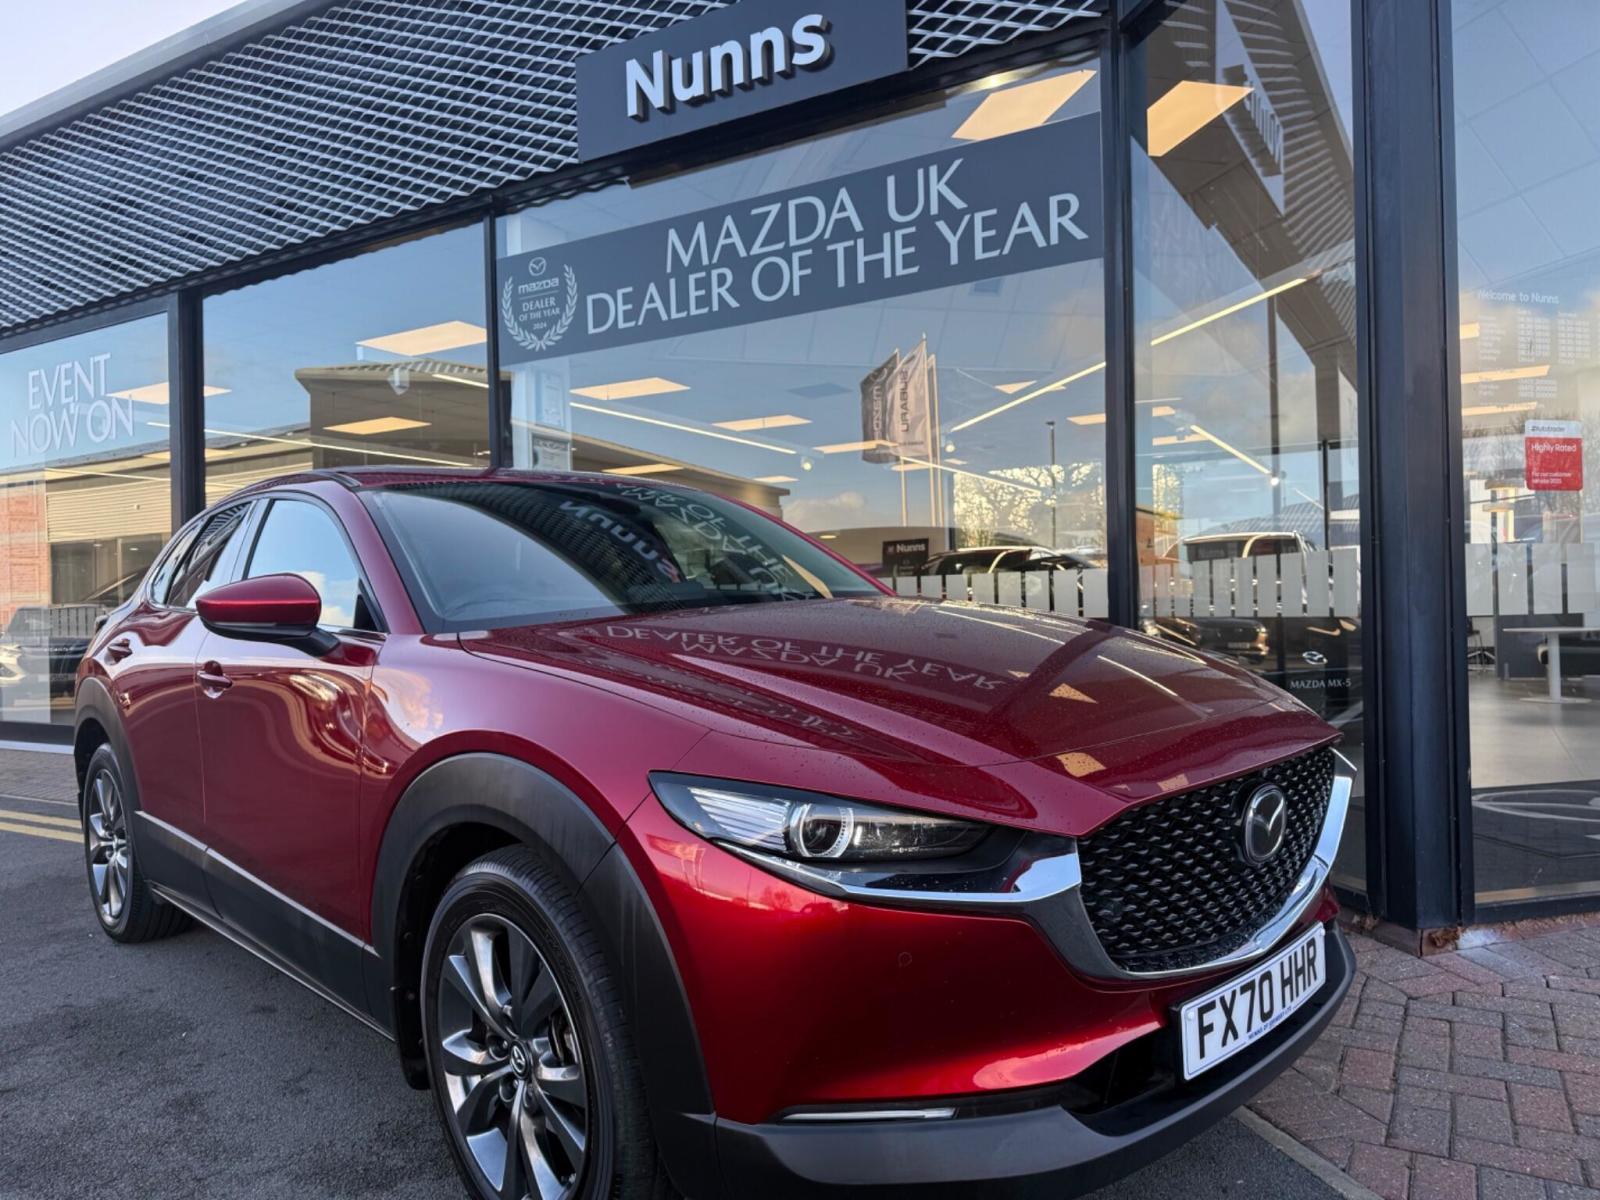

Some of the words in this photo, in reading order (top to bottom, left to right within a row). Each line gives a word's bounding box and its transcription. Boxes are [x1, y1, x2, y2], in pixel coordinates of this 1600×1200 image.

[625, 13, 829, 119] Nunns
[666, 186, 864, 274] MAZDA
[886, 157, 969, 223] UK
[586, 267, 740, 335] DEALER
[751, 248, 813, 302] OF
[826, 226, 920, 288] THE
[934, 192, 1089, 266] YEAR
[518, 277, 559, 294] mazda
[522, 296, 556, 312] DEALER
[1478, 289, 1517, 302] Welcome
[1519, 291, 1530, 303] to
[1531, 292, 1560, 304] Nunns
[519, 313, 528, 322] OF
[530, 310, 541, 320] THE
[543, 307, 560, 317] YEAR
[28, 352, 112, 410] EVENT
[10, 404, 80, 458] NOW
[86, 394, 135, 443] ON
[1531, 442, 1554, 453] Highly
[1555, 443, 1577, 453] Rated
[896, 543, 926, 553] Nunns
[1290, 679, 1325, 689] MAZDA
[1327, 678, 1352, 688] MX-5
[1197, 970, 1274, 1061] FX70
[1280, 937, 1317, 1010] HHR
